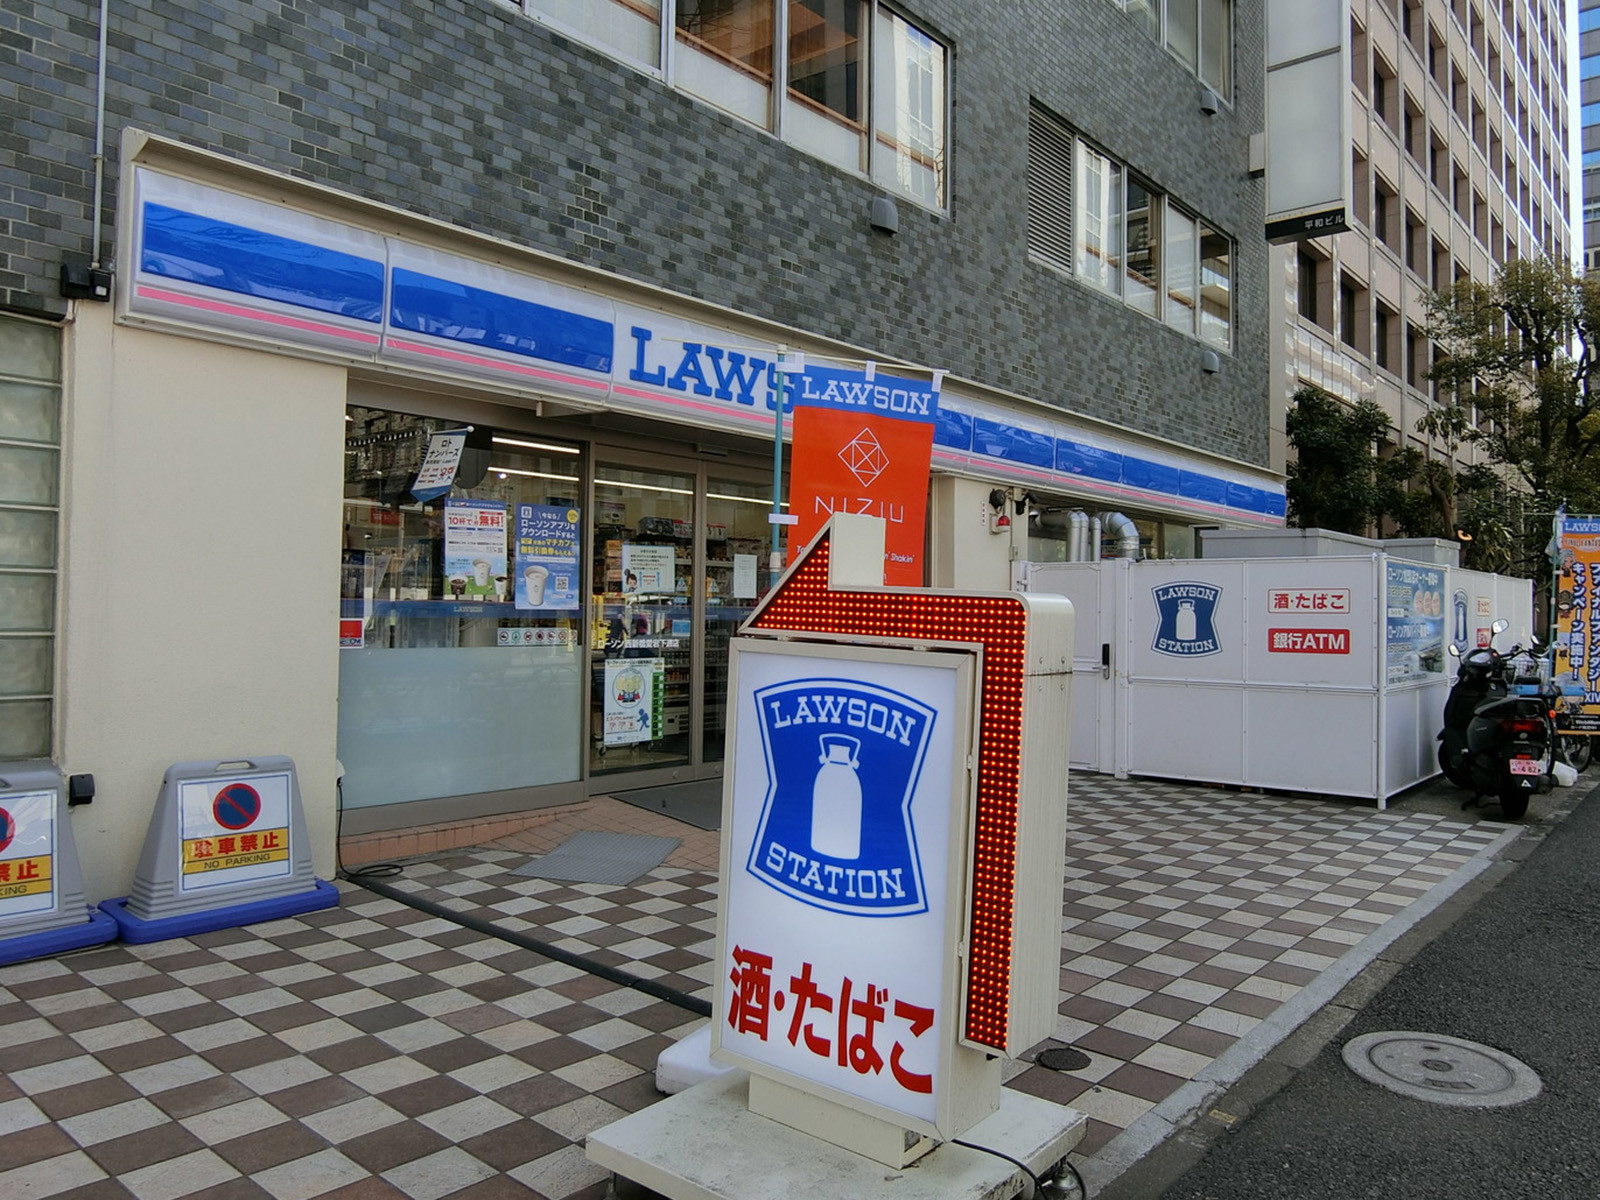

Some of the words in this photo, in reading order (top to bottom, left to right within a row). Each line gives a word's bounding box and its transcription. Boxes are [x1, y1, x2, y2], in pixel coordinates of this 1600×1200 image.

[1304, 214, 1344, 230] 平和ビル
[629, 325, 795, 414] LAWS
[802, 376, 931, 415] LAWSON
[429, 447, 460, 459] ナンバーズ
[521, 519, 576, 531] ローソンアプリを
[521, 527, 576, 538] ダウンロードすると
[1565, 522, 1600, 532] LAWS
[1158, 586, 1216, 601] LAWSON
[1274, 592, 1345, 610] 酒・たばこ
[1158, 637, 1215, 653] STATION
[1273, 632, 1345, 650] 銀行ATM
[770, 695, 917, 747] LAWSON
[195, 832, 279, 858] 駐車禁止
[204, 860, 220, 869] NO
[225, 853, 271, 866] PARKING
[765, 841, 907, 899] STATION
[727, 944, 935, 1094] 酒・たばこ
